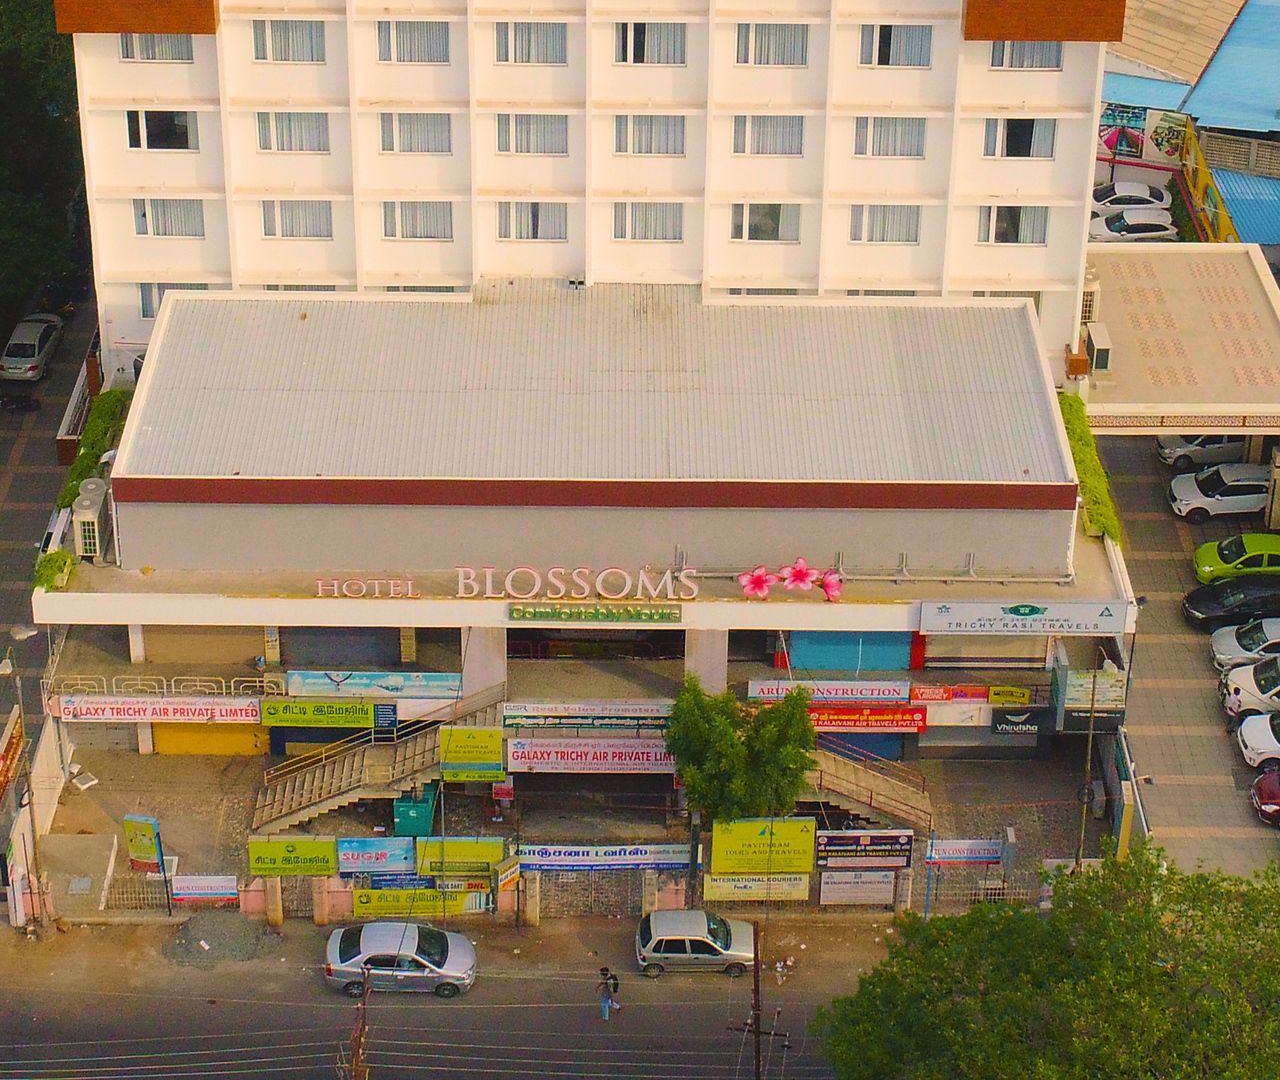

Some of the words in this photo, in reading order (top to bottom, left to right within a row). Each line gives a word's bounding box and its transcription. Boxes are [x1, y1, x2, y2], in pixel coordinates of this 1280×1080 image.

[315, 578, 420, 599] HOTEL
[455, 565, 700, 600] BLOSSOMS
[509, 604, 623, 622] Comfortably
[806, 687, 902, 697] ONSTRUCTION
[62, 707, 106, 717] GALAXY
[109, 707, 148, 717] TRICHY
[151, 707, 169, 717] AIR
[172, 707, 216, 718] PRIVATE
[219, 707, 258, 718] LIMTED
[511, 751, 551, 761] GALAXY
[554, 751, 589, 761] TRICHY
[591, 751, 611, 761] AIR
[613, 751, 652, 761] PRIVATE
[947, 847, 999, 856] CONSTRUCTION
[467, 882, 486, 890] DHL
